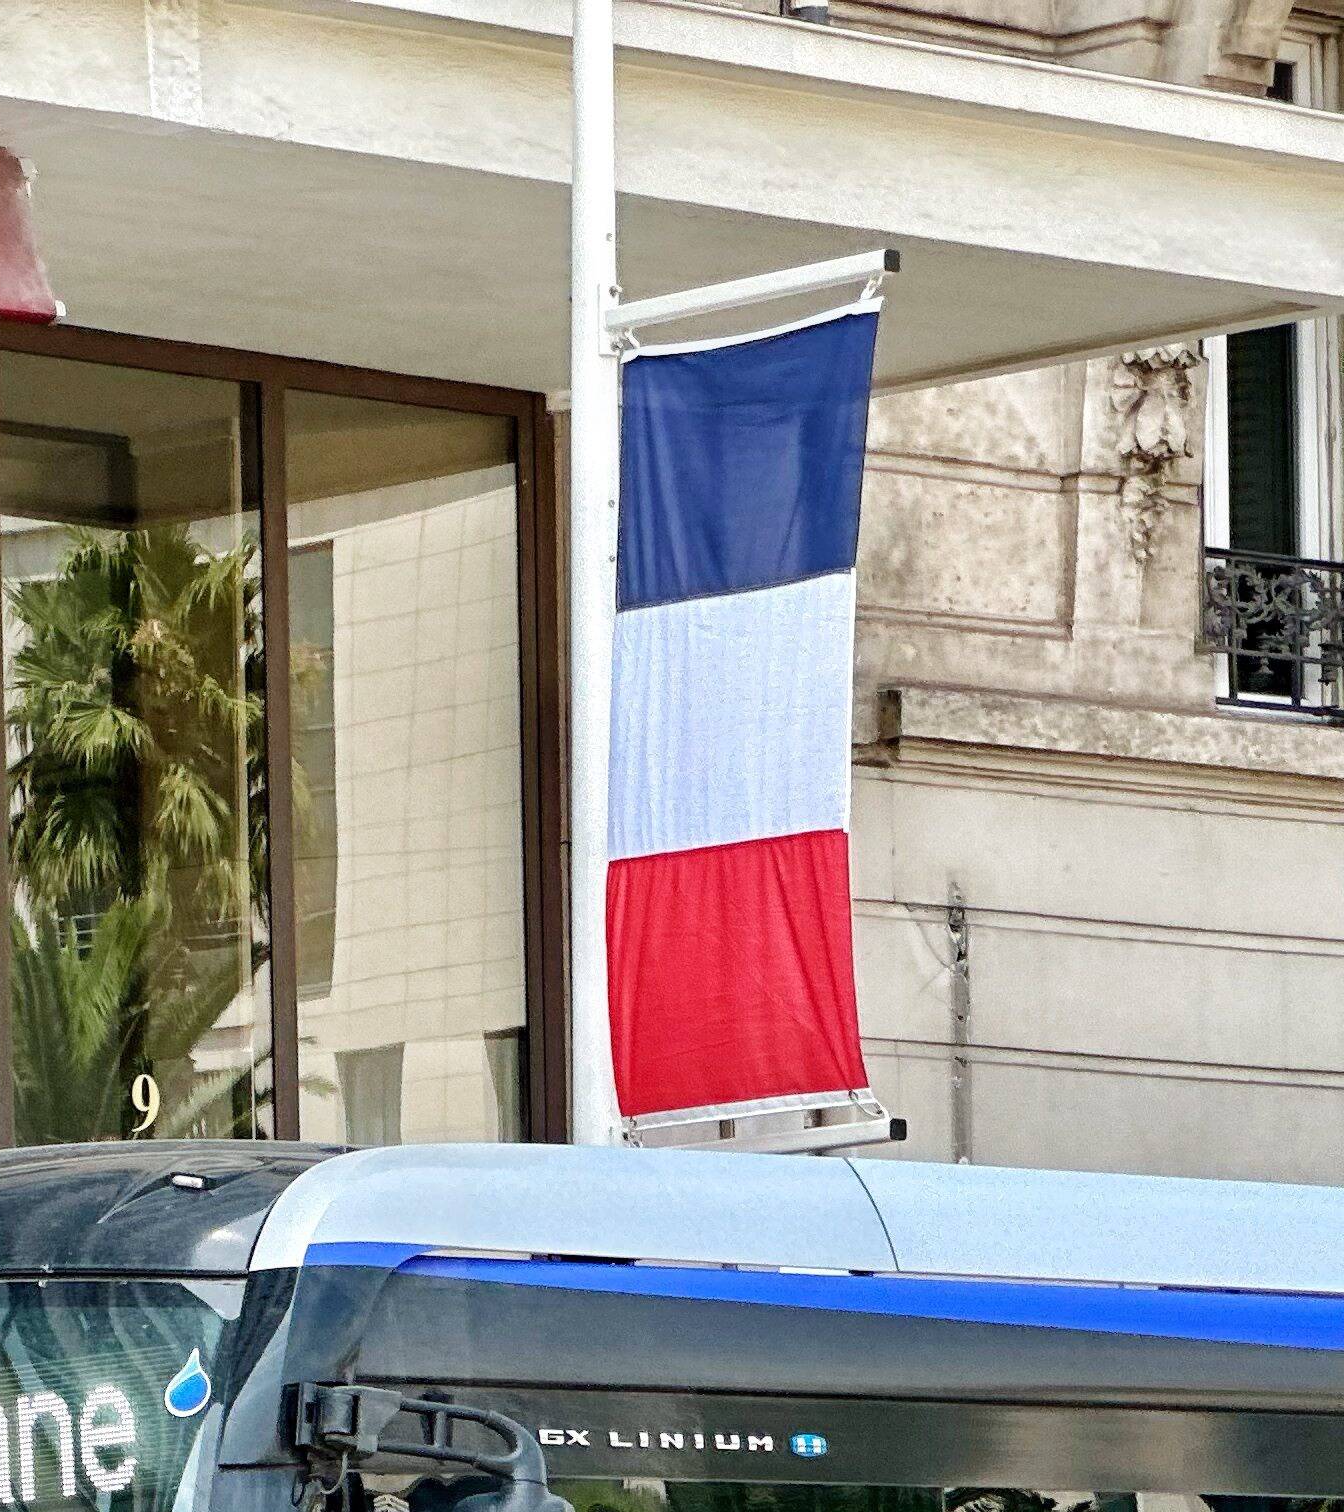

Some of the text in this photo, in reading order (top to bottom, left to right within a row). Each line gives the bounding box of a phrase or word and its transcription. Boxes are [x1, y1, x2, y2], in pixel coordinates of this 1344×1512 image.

[131, 1073, 161, 1133] 9
[538, 1429, 590, 1446] GX
[609, 1431, 774, 1451] LINIUM
